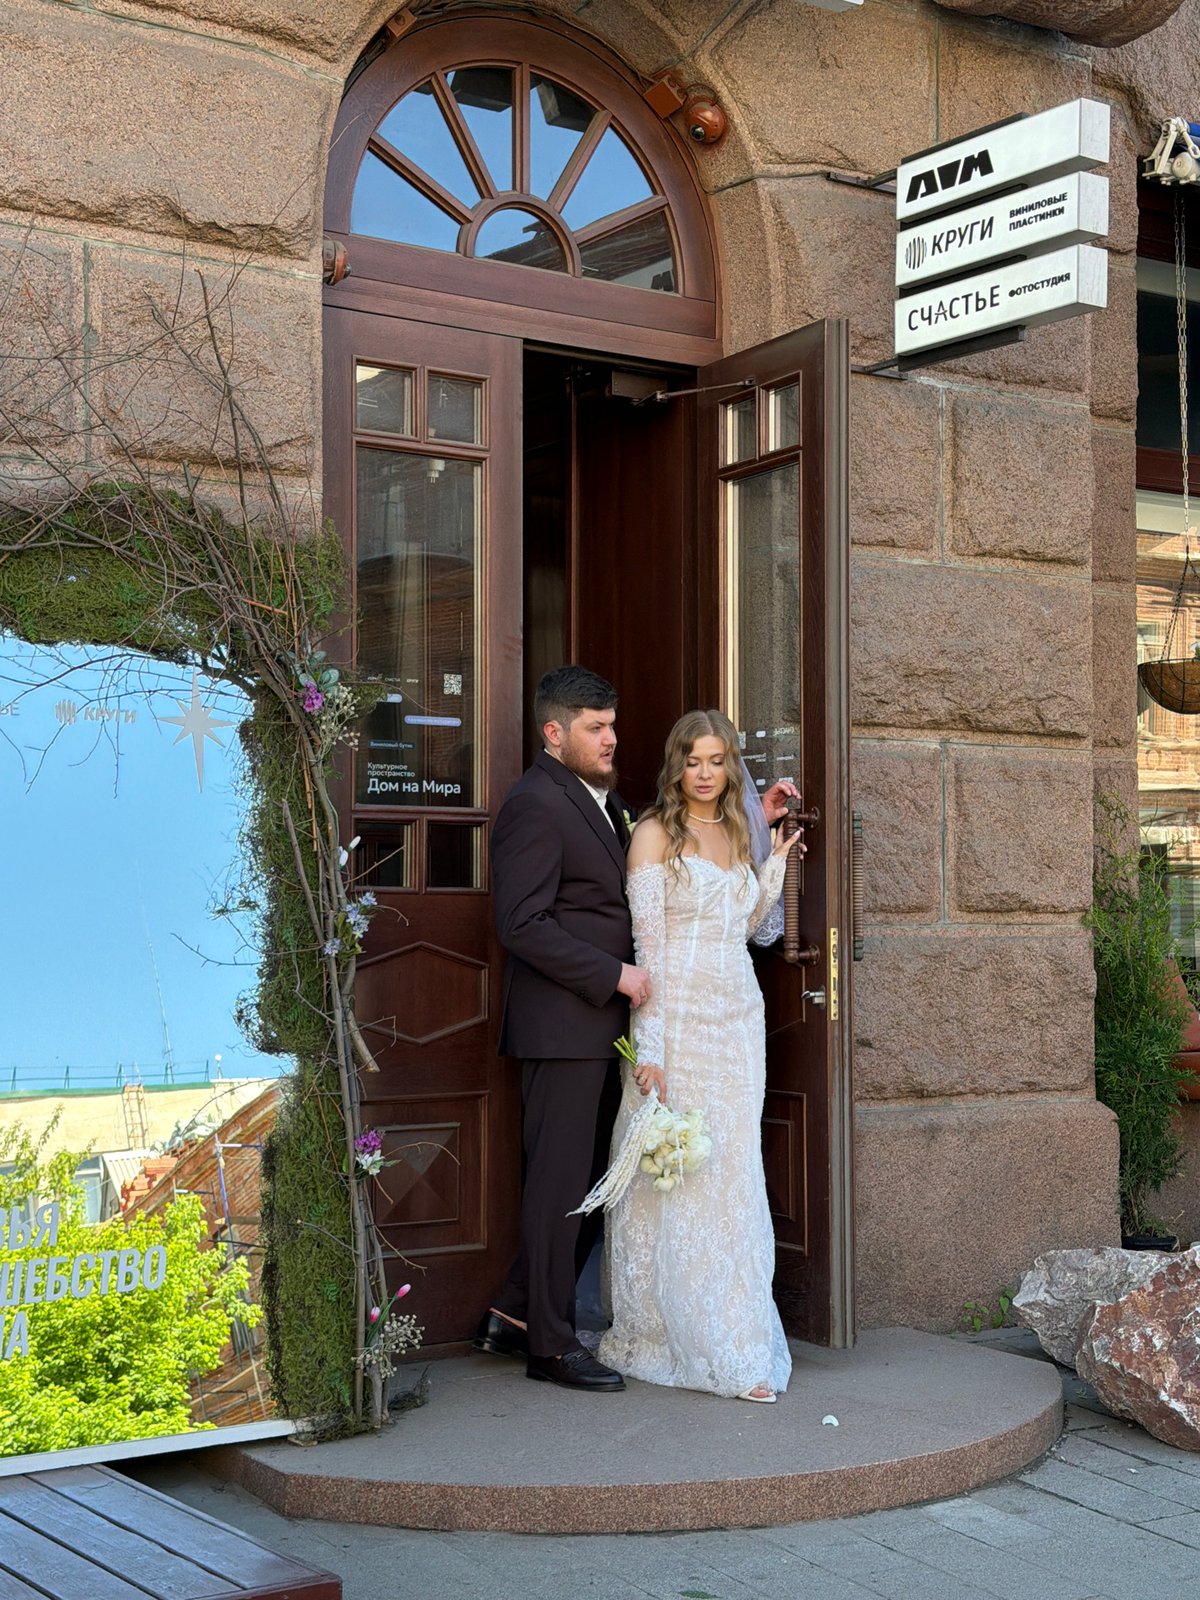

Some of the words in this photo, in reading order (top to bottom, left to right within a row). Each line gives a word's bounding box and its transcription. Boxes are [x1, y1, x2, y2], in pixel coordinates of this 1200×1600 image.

[1009, 192, 1068, 218] ВИНИЛОВЫЕ
[1008, 206, 1065, 231] ПЛАСТИНКИ
[931, 216, 994, 256] КРУГИ
[908, 285, 1000, 331] СЧАСТЬЕ
[1008, 272, 1071, 298] ФОТОСТУДИЯ
[84, 706, 136, 724] КРУГИ
[367, 762, 408, 771] Культурное
[367, 769, 416, 778] пространство
[367, 778, 399, 794] Дом
[402, 782, 419, 793] на
[422, 780, 461, 797] Мира
